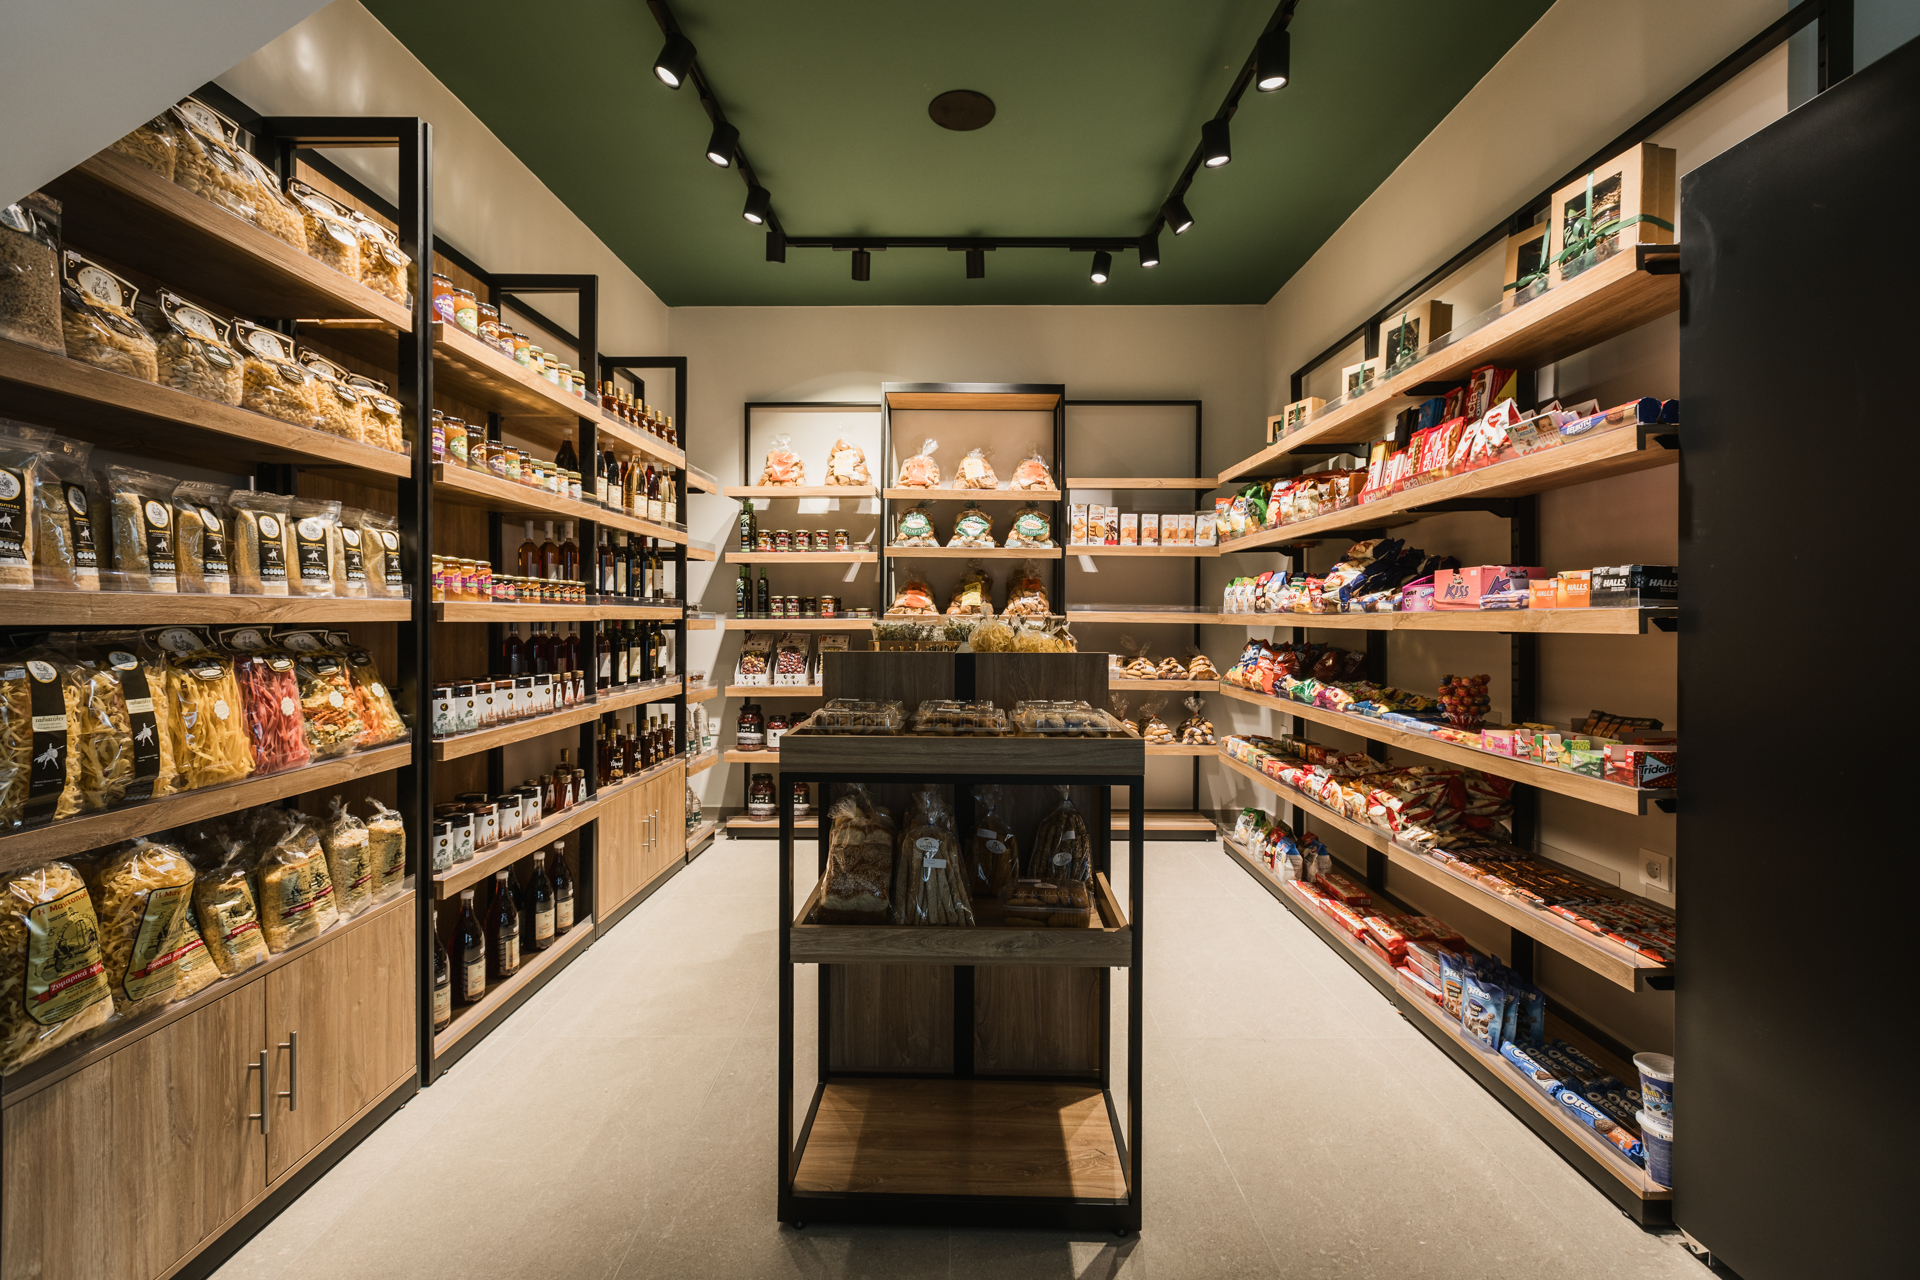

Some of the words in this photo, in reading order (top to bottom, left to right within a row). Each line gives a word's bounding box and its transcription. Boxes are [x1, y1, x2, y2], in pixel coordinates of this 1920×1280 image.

[1444, 583, 1470, 600] KISS
[1639, 764, 1676, 775] Trident
[51, 969, 88, 992] Ζυμαρικά
[1467, 985, 1490, 1001] OREO
[1525, 1047, 1561, 1070] OREO
[1548, 1047, 1585, 1073] OREO
[1562, 1091, 1605, 1119] OREO
[1587, 1091, 1628, 1118] OREO
